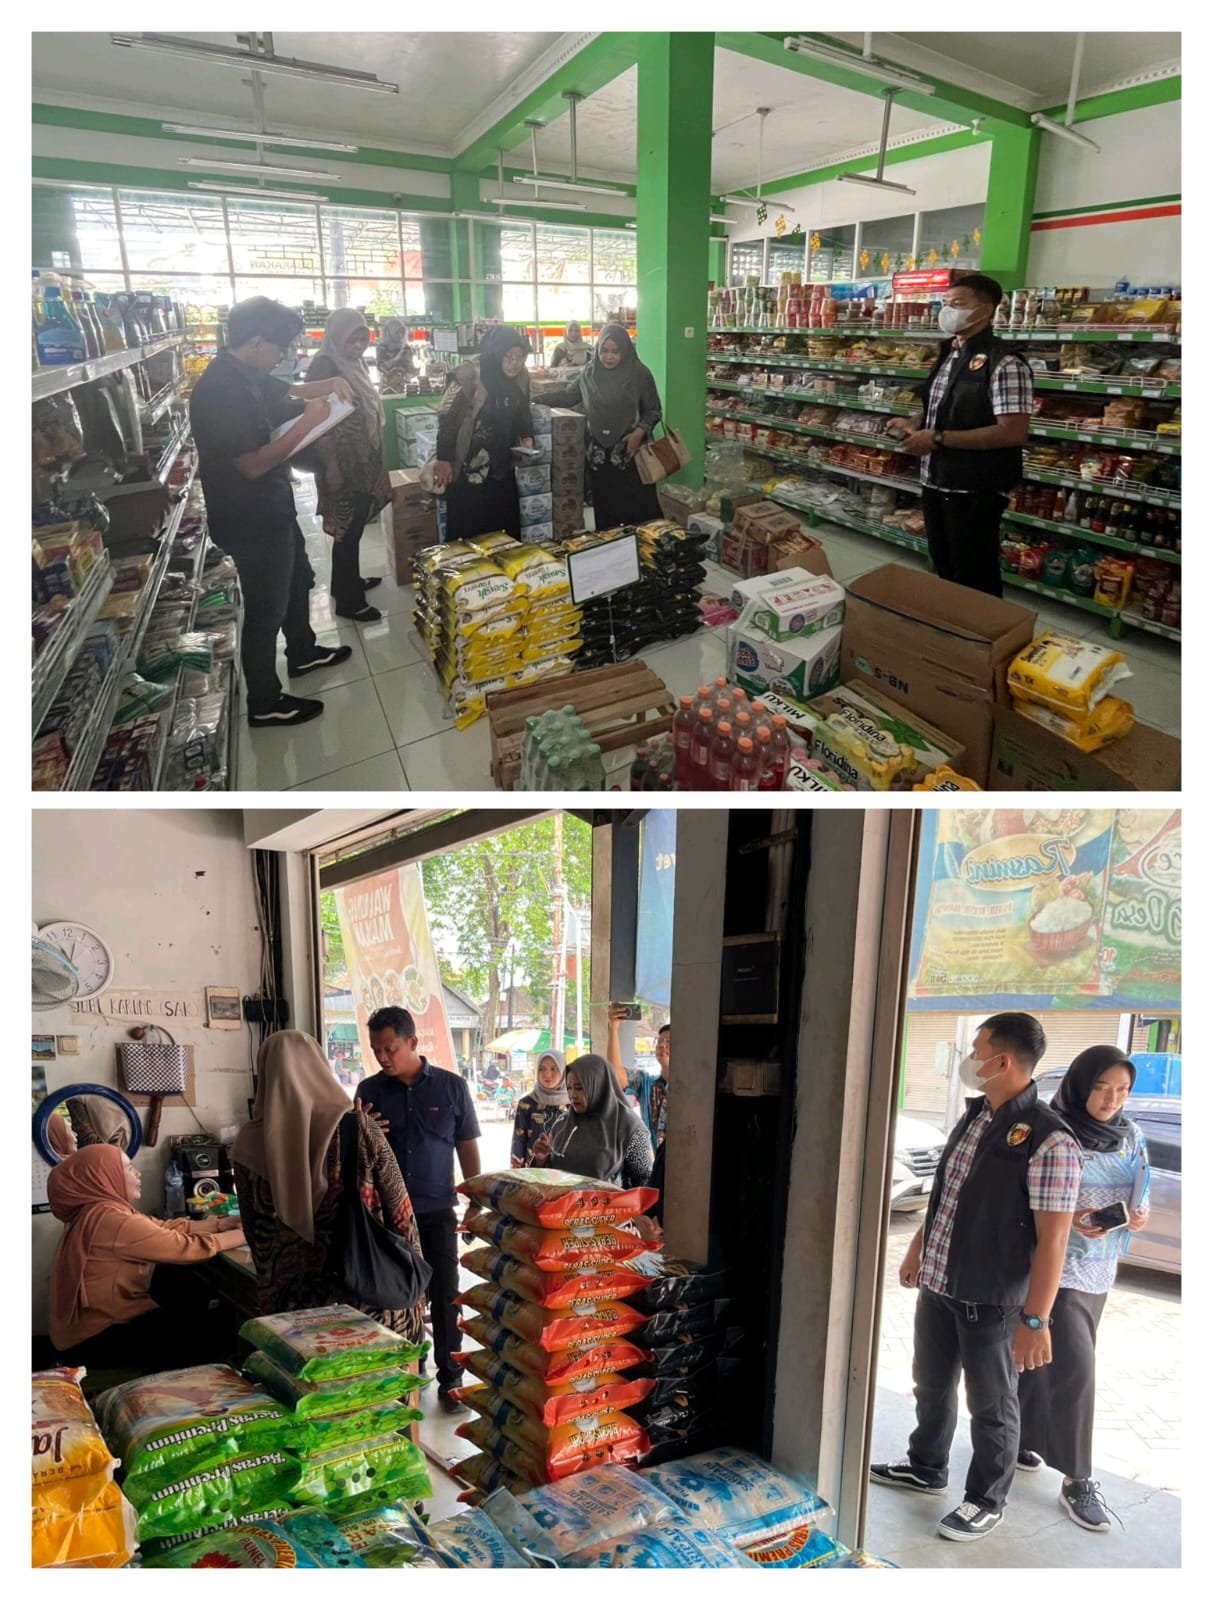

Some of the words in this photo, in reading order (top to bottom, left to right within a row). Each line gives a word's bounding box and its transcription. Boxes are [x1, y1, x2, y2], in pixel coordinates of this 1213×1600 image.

[765, 694, 806, 720] MILKU
[841, 709, 886, 743] Floridina
[815, 739, 859, 780] Floridina
[62, 927, 73, 938] 12
[84, 982, 94, 992] 5
[145, 1419, 228, 1452] Premium
[232, 1451, 286, 1475] Beras
[151, 1466, 231, 1502] Premium
[238, 1537, 267, 1568] PUNEL
